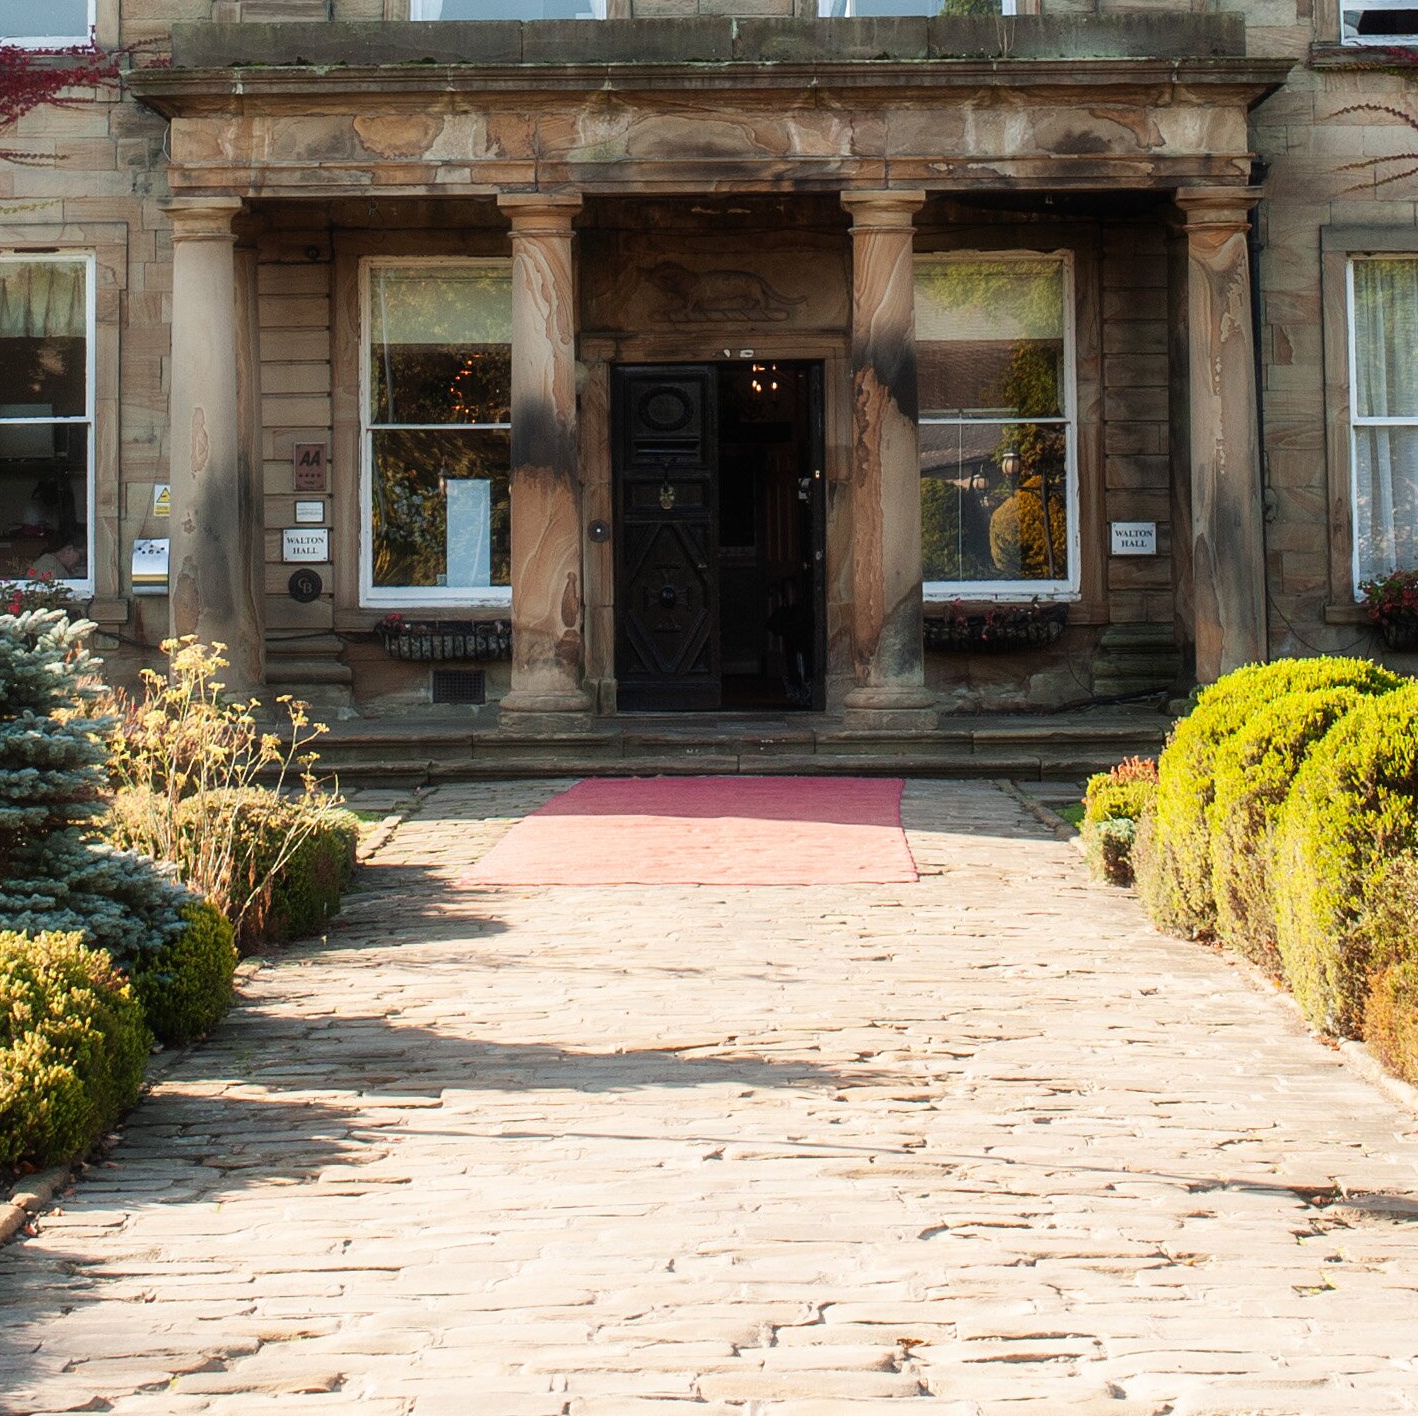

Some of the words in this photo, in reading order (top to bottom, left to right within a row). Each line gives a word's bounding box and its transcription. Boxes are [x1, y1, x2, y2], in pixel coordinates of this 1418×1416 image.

[299, 450, 321, 466] AA
[1114, 529, 1153, 538] WALTON
[286, 536, 325, 545] WALTON
[1121, 540, 1148, 548] HALL
[292, 546, 319, 555] HALL
